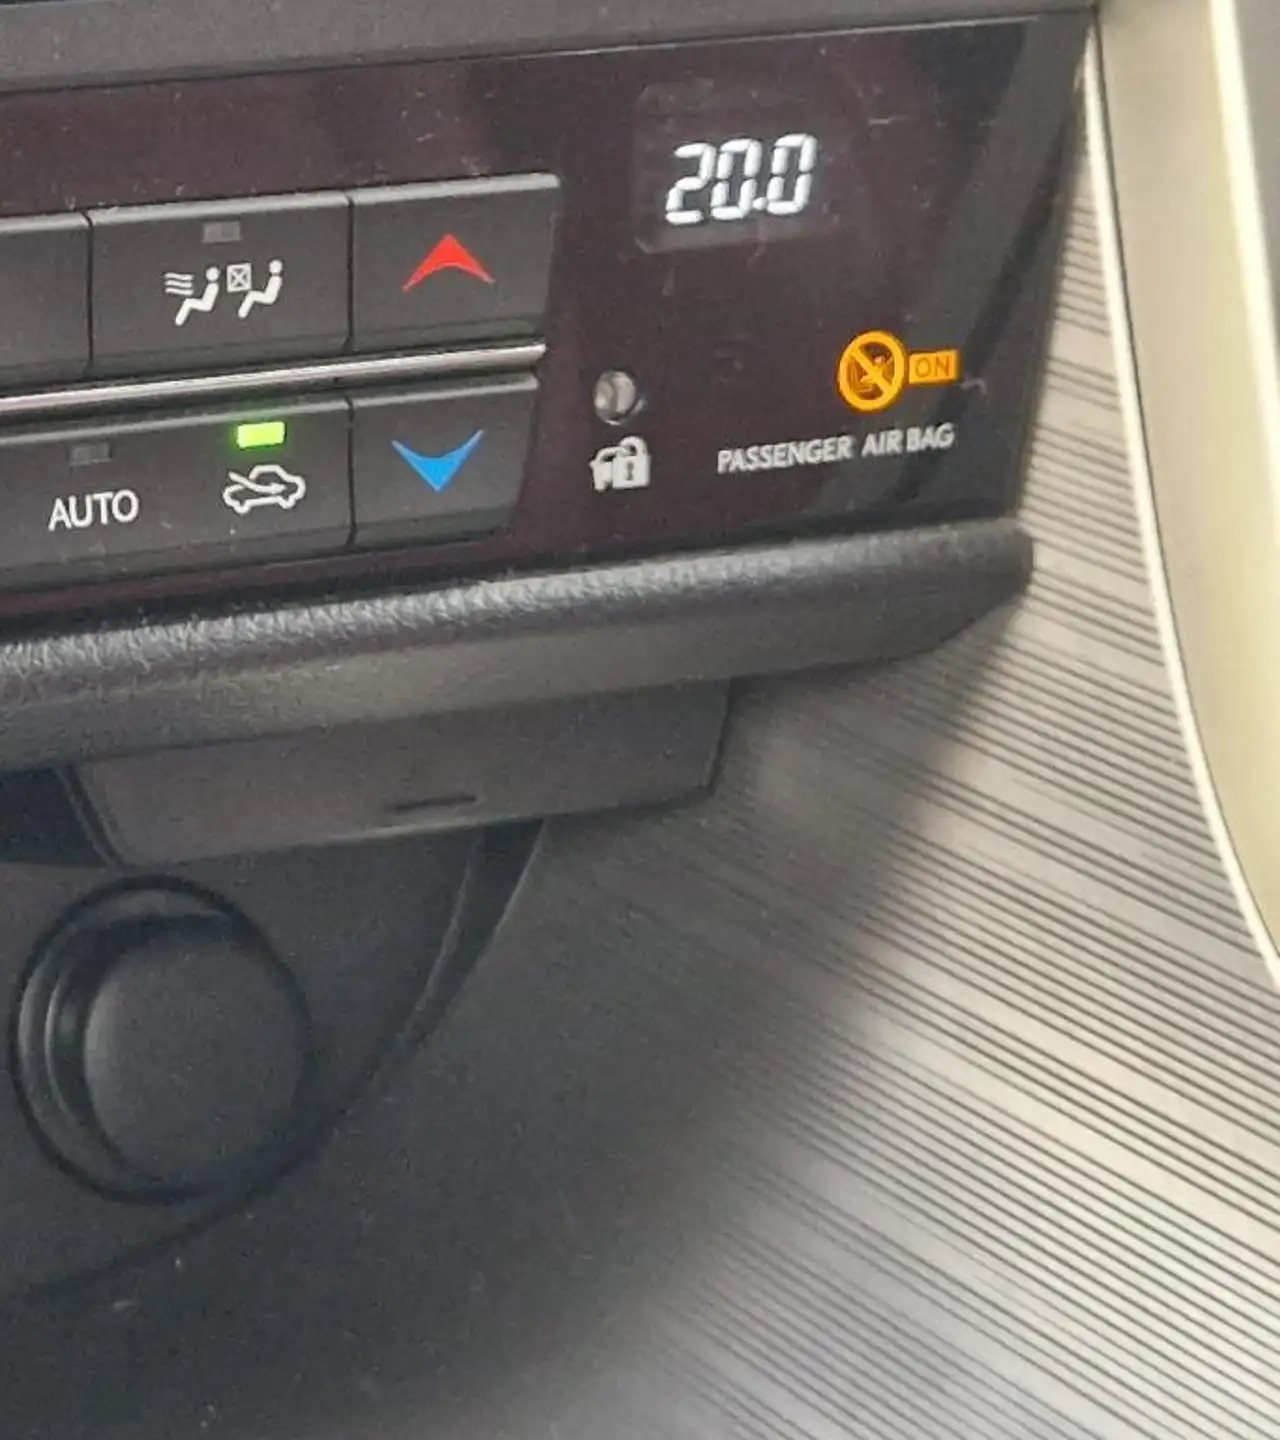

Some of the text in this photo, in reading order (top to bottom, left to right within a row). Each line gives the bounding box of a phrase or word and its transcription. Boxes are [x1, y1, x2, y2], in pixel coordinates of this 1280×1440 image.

[665, 133, 817, 225] 20.0
[914, 359, 952, 379] ON
[717, 422, 956, 474] PASSENGER AIR BAG
[48, 488, 140, 532] AUTO
